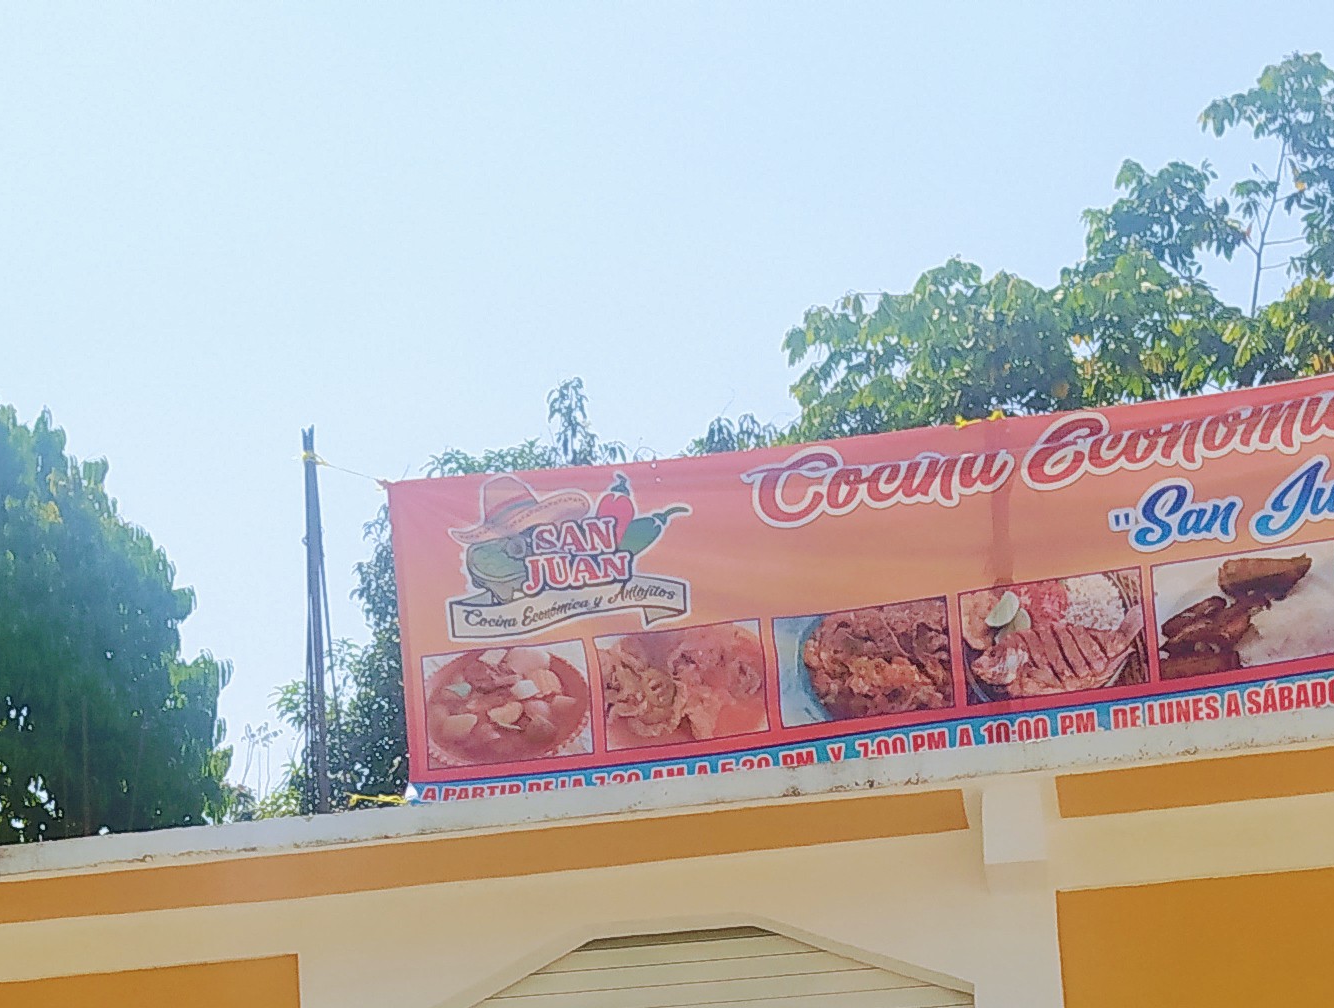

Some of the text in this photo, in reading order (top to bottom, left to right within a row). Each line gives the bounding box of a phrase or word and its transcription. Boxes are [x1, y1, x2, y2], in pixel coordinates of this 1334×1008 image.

[744, 447, 1012, 527] Cocina
[535, 519, 615, 551] SAN
[525, 554, 629, 591] JUAN
[463, 608, 518, 629] Cocina
[607, 584, 676, 605] Antojitos
[421, 787, 438, 801] A
[911, 730, 947, 753] PM
[957, 727, 973, 747] A
[982, 717, 1049, 744] 10:00
[1112, 705, 1141, 729] DE
[1147, 695, 1219, 727] LUNES
[1224, 692, 1242, 718] A
